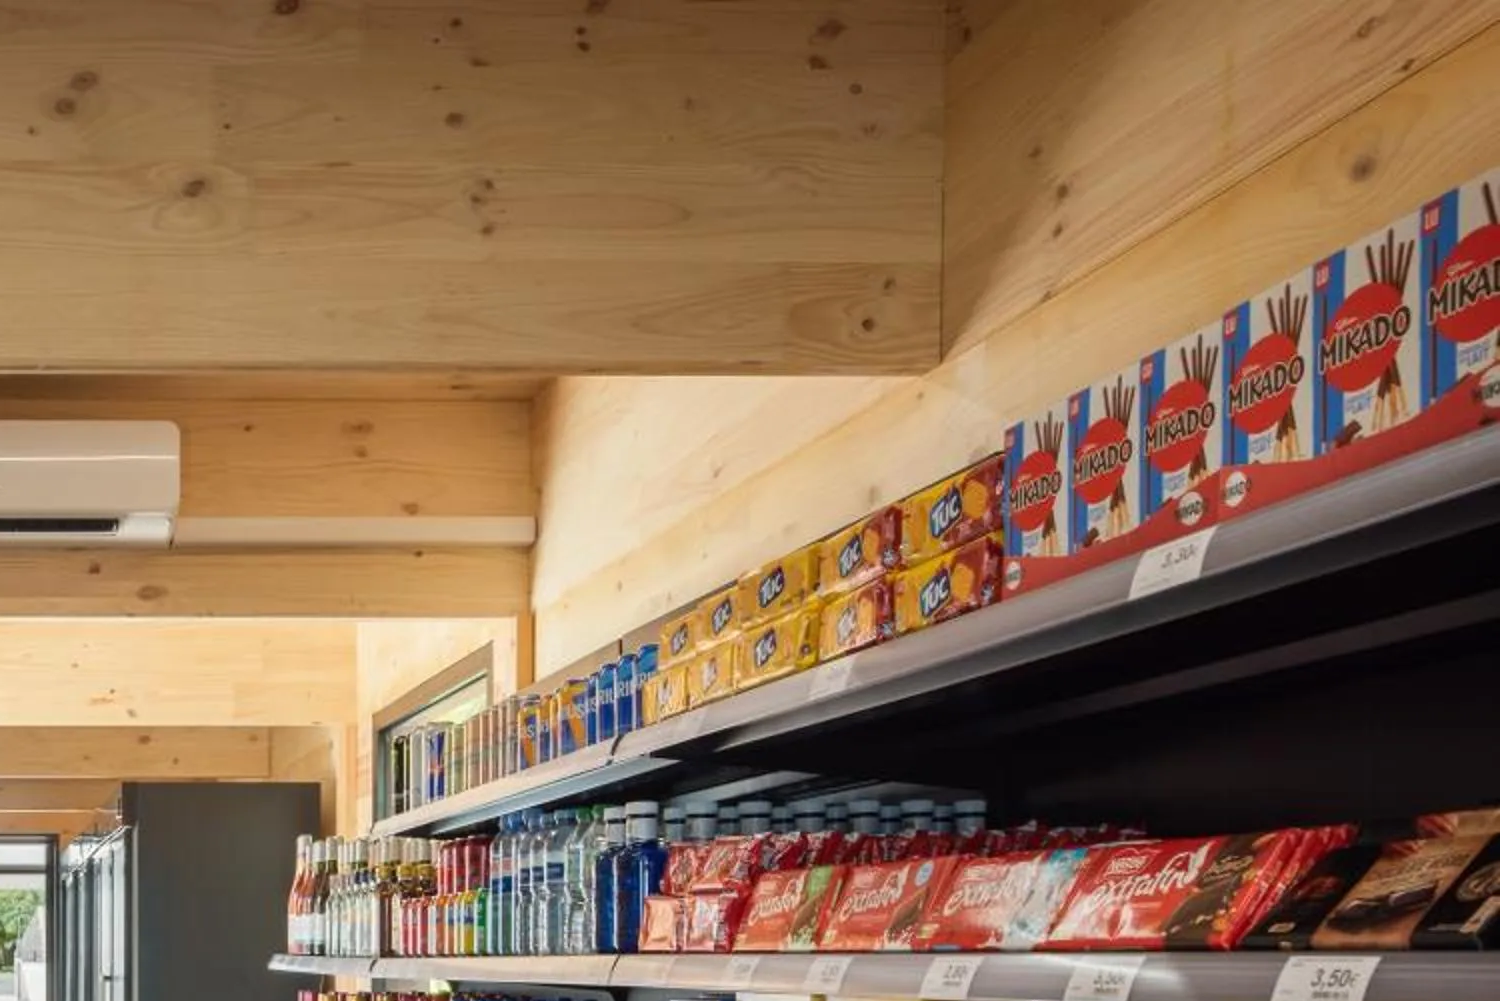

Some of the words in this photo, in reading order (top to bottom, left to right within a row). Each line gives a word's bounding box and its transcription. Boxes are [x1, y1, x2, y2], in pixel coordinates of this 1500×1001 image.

[1318, 306, 1412, 374] MIKADO
[1227, 356, 1305, 416] MIKADO
[1145, 402, 1215, 456] MIKADO
[1073, 439, 1133, 484] MIKADO
[1009, 472, 1062, 508] MIKADO
[932, 498, 961, 534] TUC
[841, 539, 862, 574] TUC
[761, 573, 783, 605] TUC
[923, 576, 949, 612] TUC
[1311, 970, 1361, 989] 3,50€
